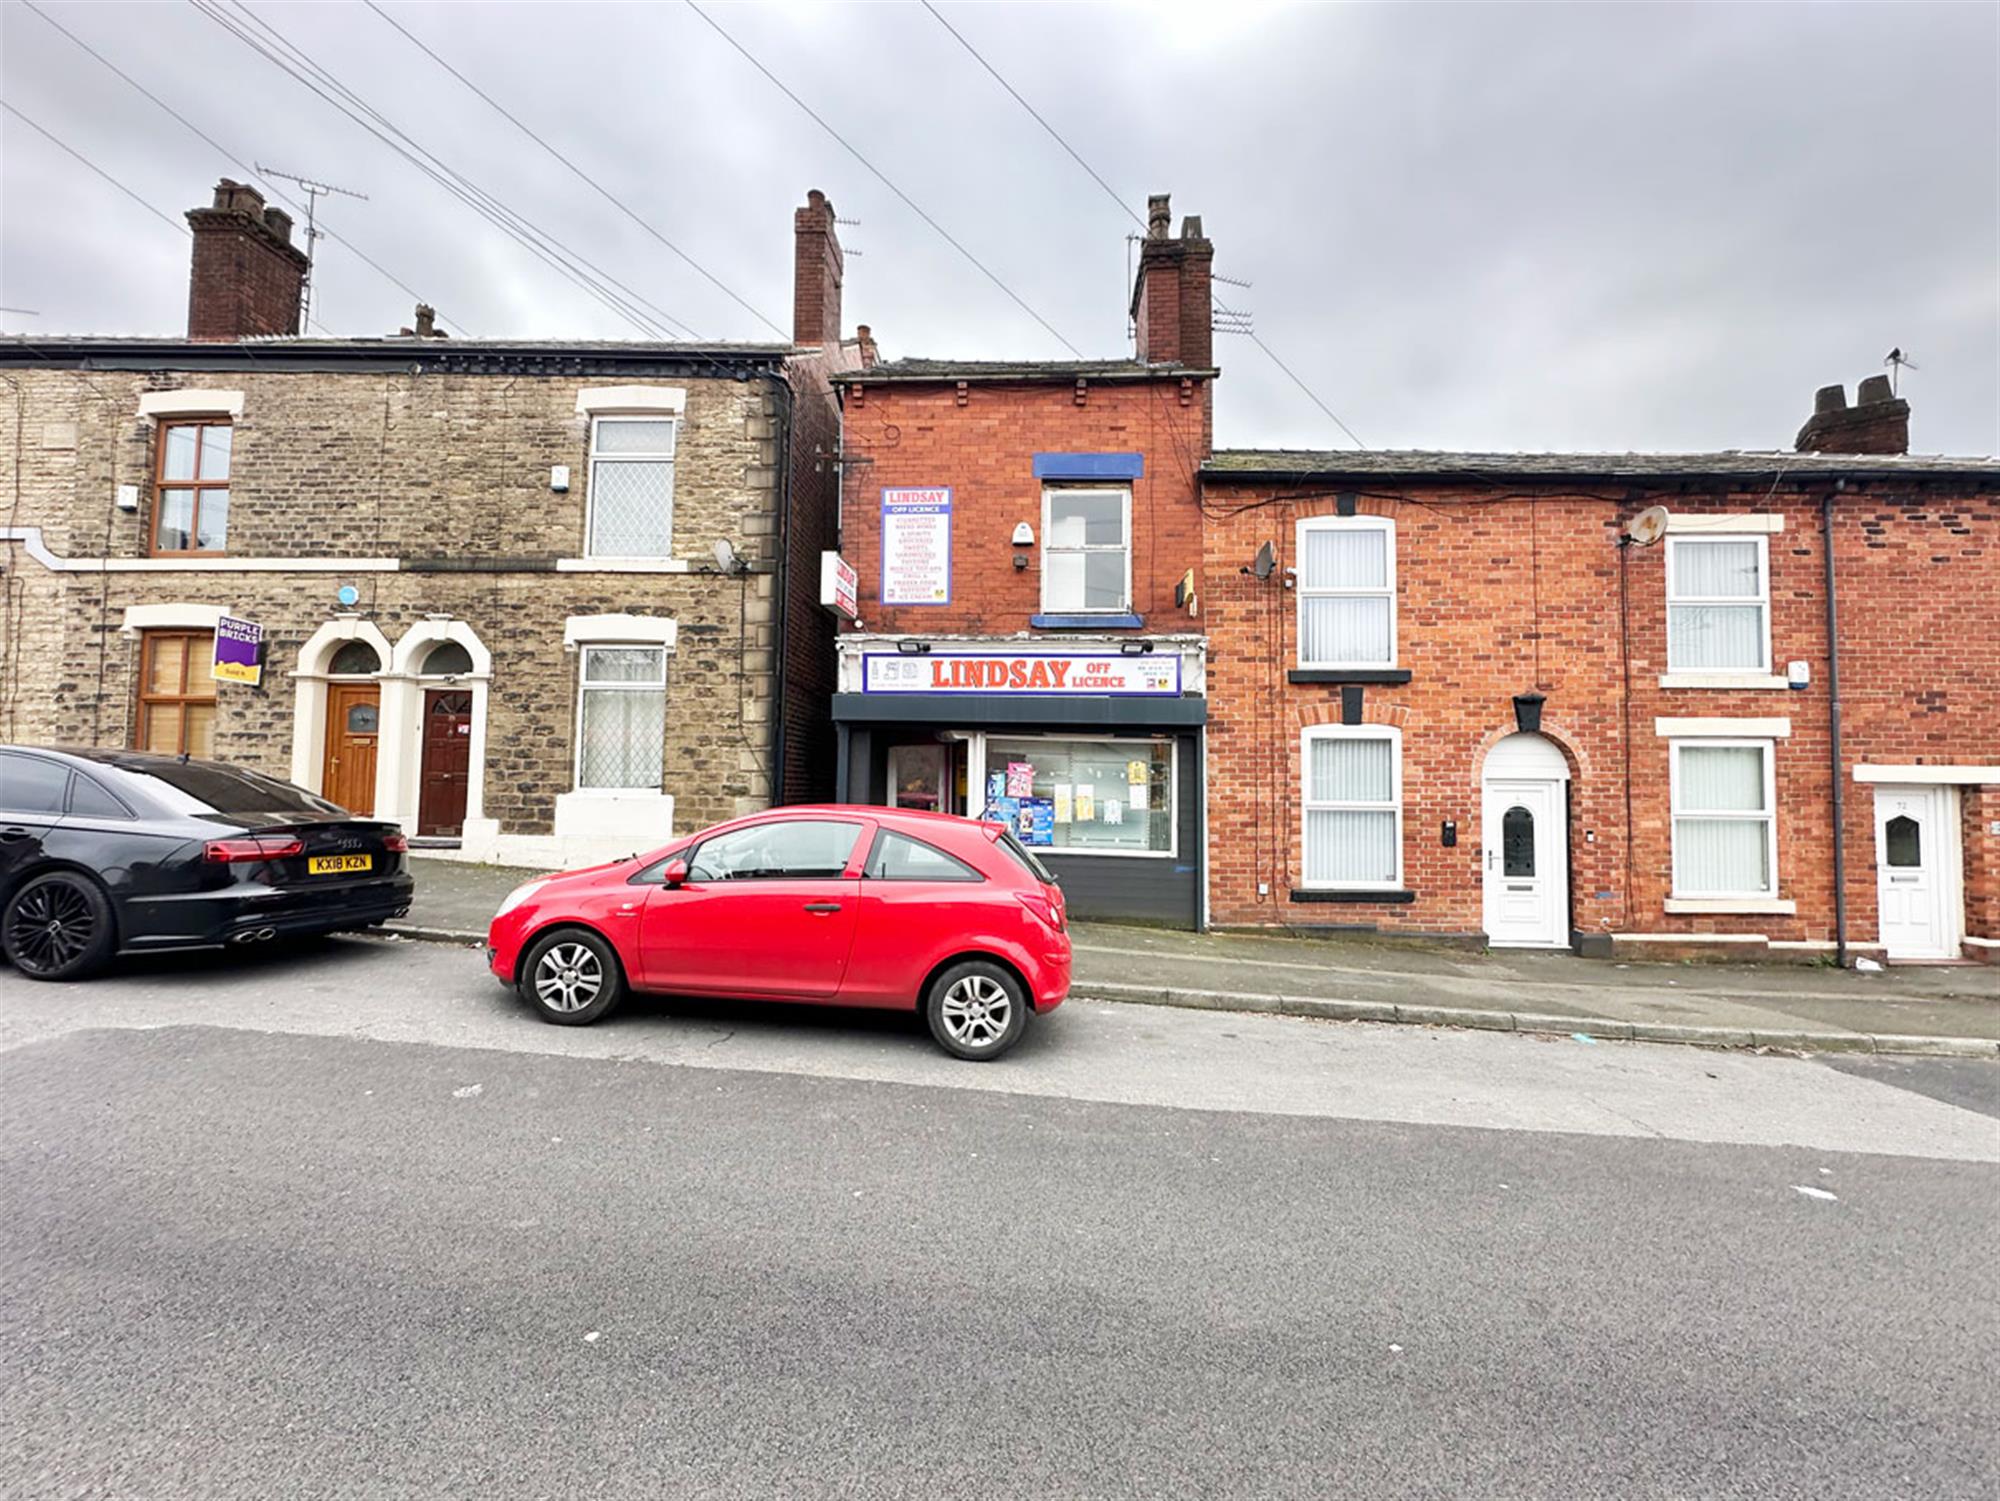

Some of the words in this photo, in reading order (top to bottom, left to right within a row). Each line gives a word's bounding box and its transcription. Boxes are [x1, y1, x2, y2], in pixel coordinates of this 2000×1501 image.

[889, 491, 945, 503] LINDSAY
[221, 618, 259, 635] PURPLE
[219, 627, 258, 644] BRICKS
[930, 659, 1071, 688] LINDSAY
[1086, 662, 1111, 673] OFF
[1072, 676, 1126, 688] LICENCE
[316, 858, 343, 871] KX18
[345, 856, 367, 869] KZN
